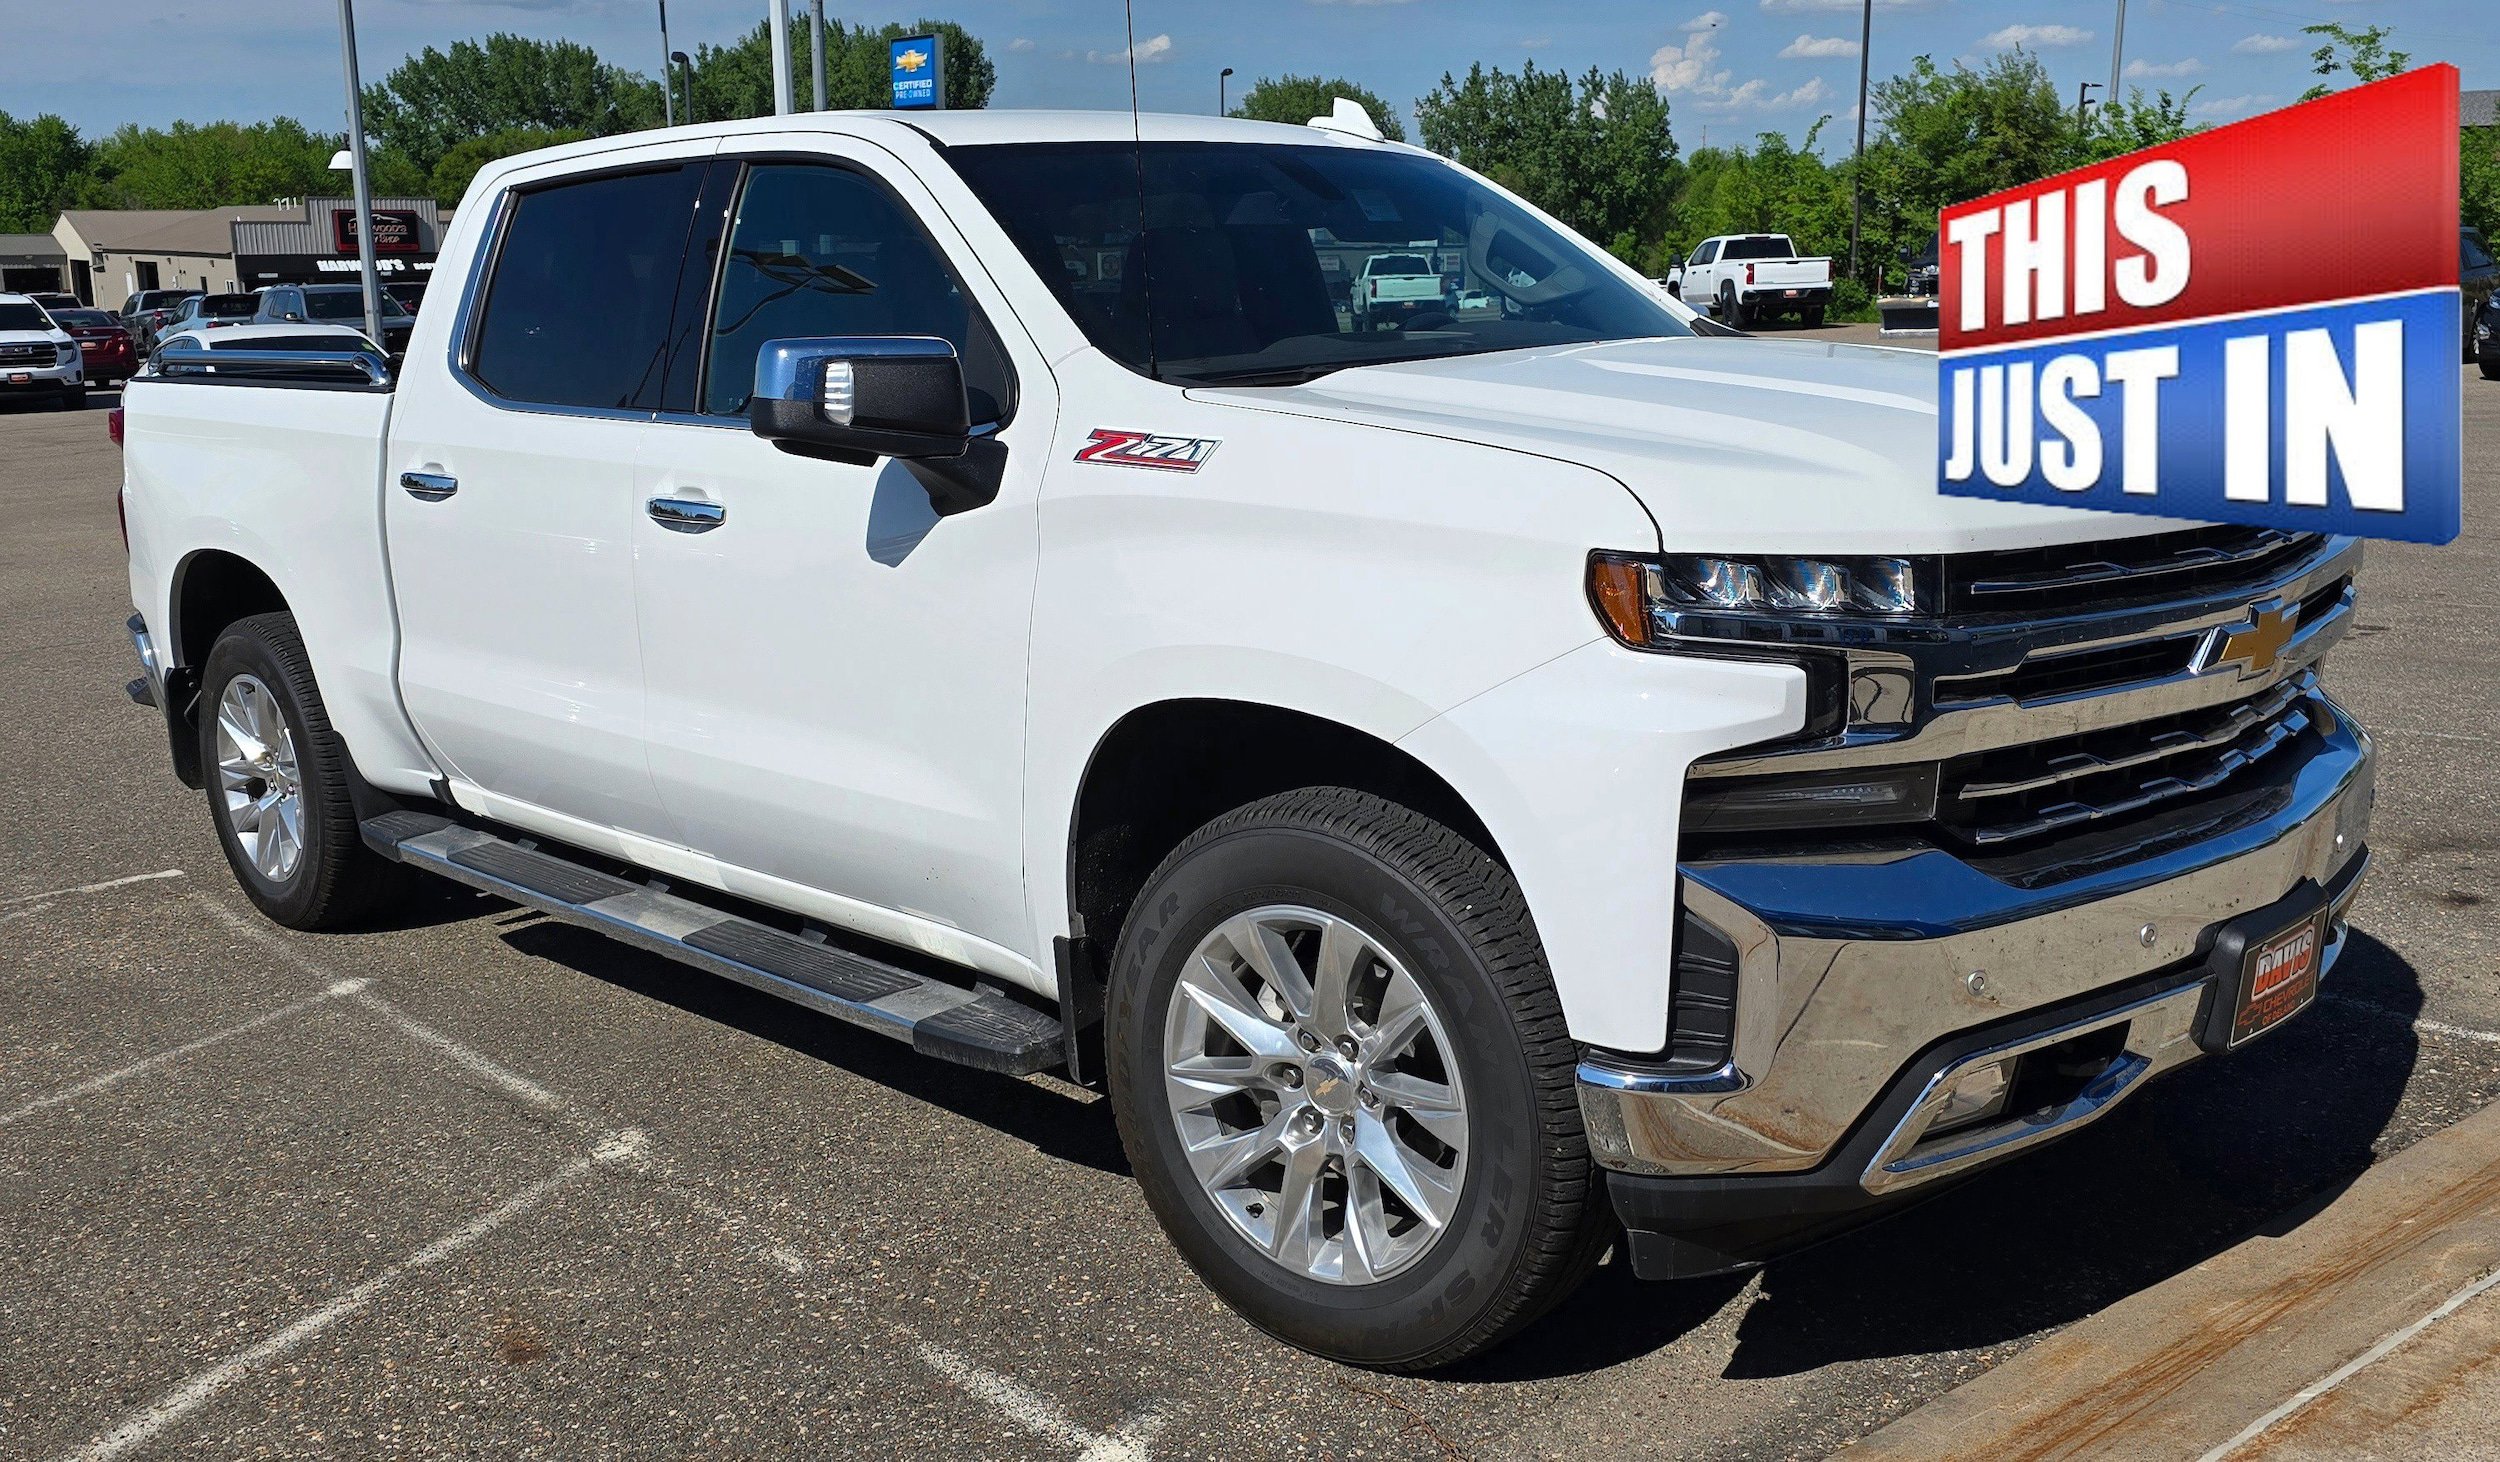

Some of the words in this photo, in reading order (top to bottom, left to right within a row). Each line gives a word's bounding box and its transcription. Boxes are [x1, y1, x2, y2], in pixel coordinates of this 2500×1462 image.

[892, 79, 932, 91] CERTIFIED
[316, 259, 406, 272] HARWD'S
[1073, 427, 1223, 475] Z71
[2254, 928, 2314, 995] DAVIS
[2262, 969, 2315, 1013] CHEVROLET
